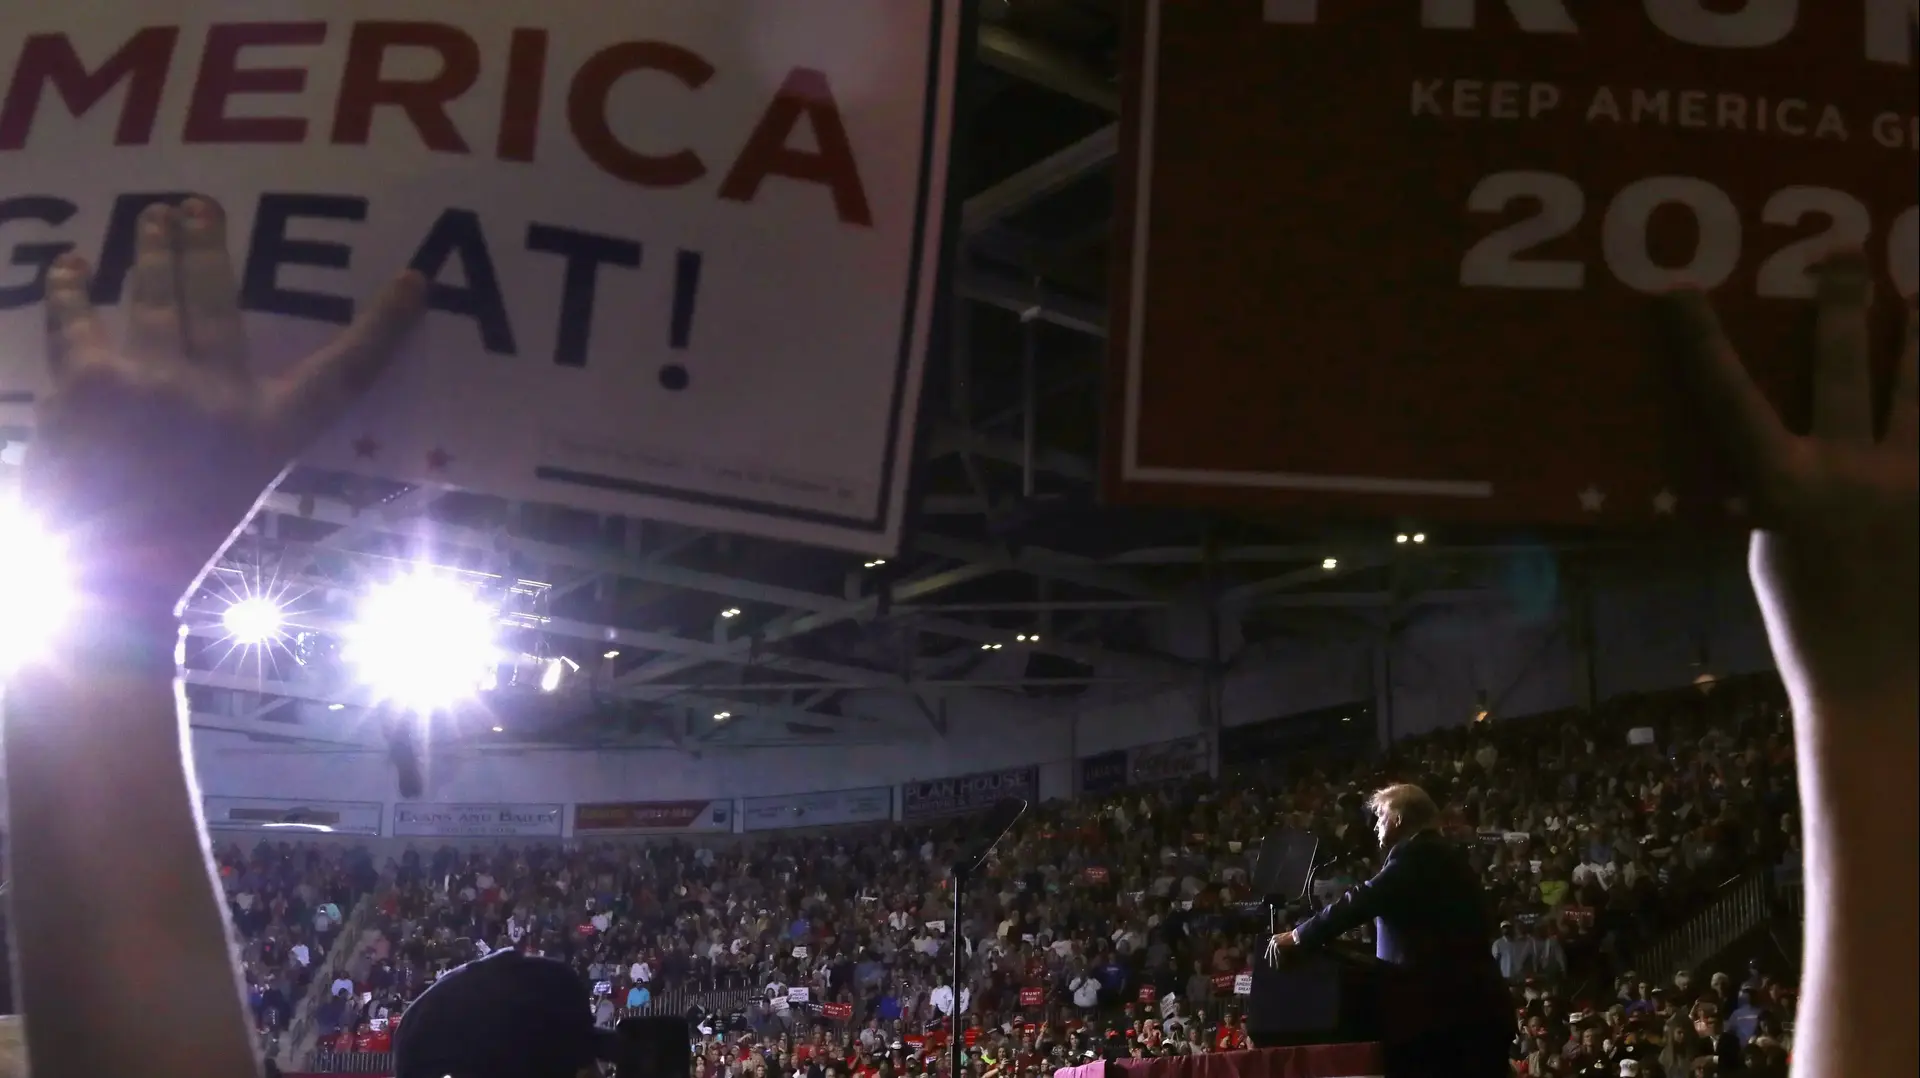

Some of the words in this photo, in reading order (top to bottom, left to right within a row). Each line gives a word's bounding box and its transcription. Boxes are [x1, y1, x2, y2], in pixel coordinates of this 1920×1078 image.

[1410, 78, 1561, 120] KEEP
[1587, 89, 1849, 142] AMERICA
[906, 779, 955, 799] PLAN
[960, 768, 1029, 795] HOUSE
